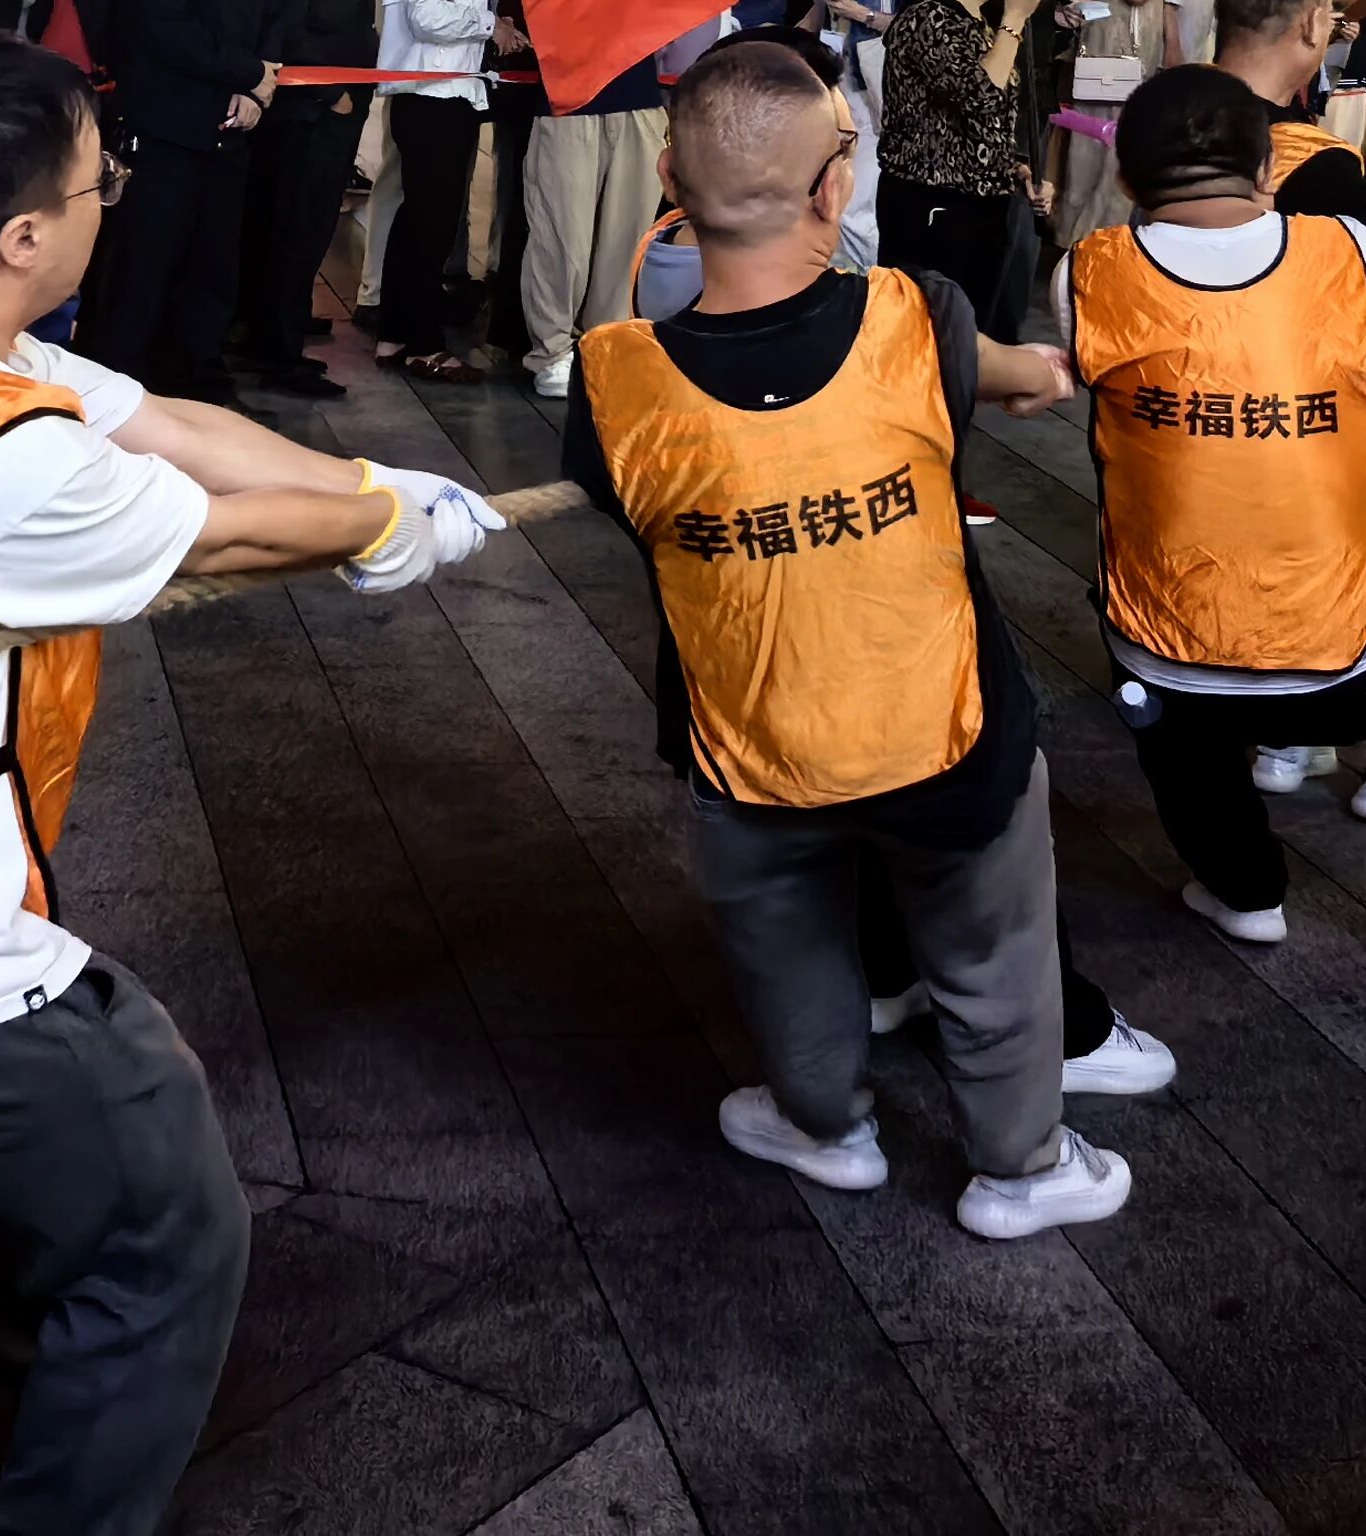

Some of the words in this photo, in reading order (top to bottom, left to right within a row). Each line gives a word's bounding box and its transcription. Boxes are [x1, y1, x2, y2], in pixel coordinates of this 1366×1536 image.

[1132, 386, 1339, 440] 幸福铁西
[674, 462, 919, 562] 幸福铁西
